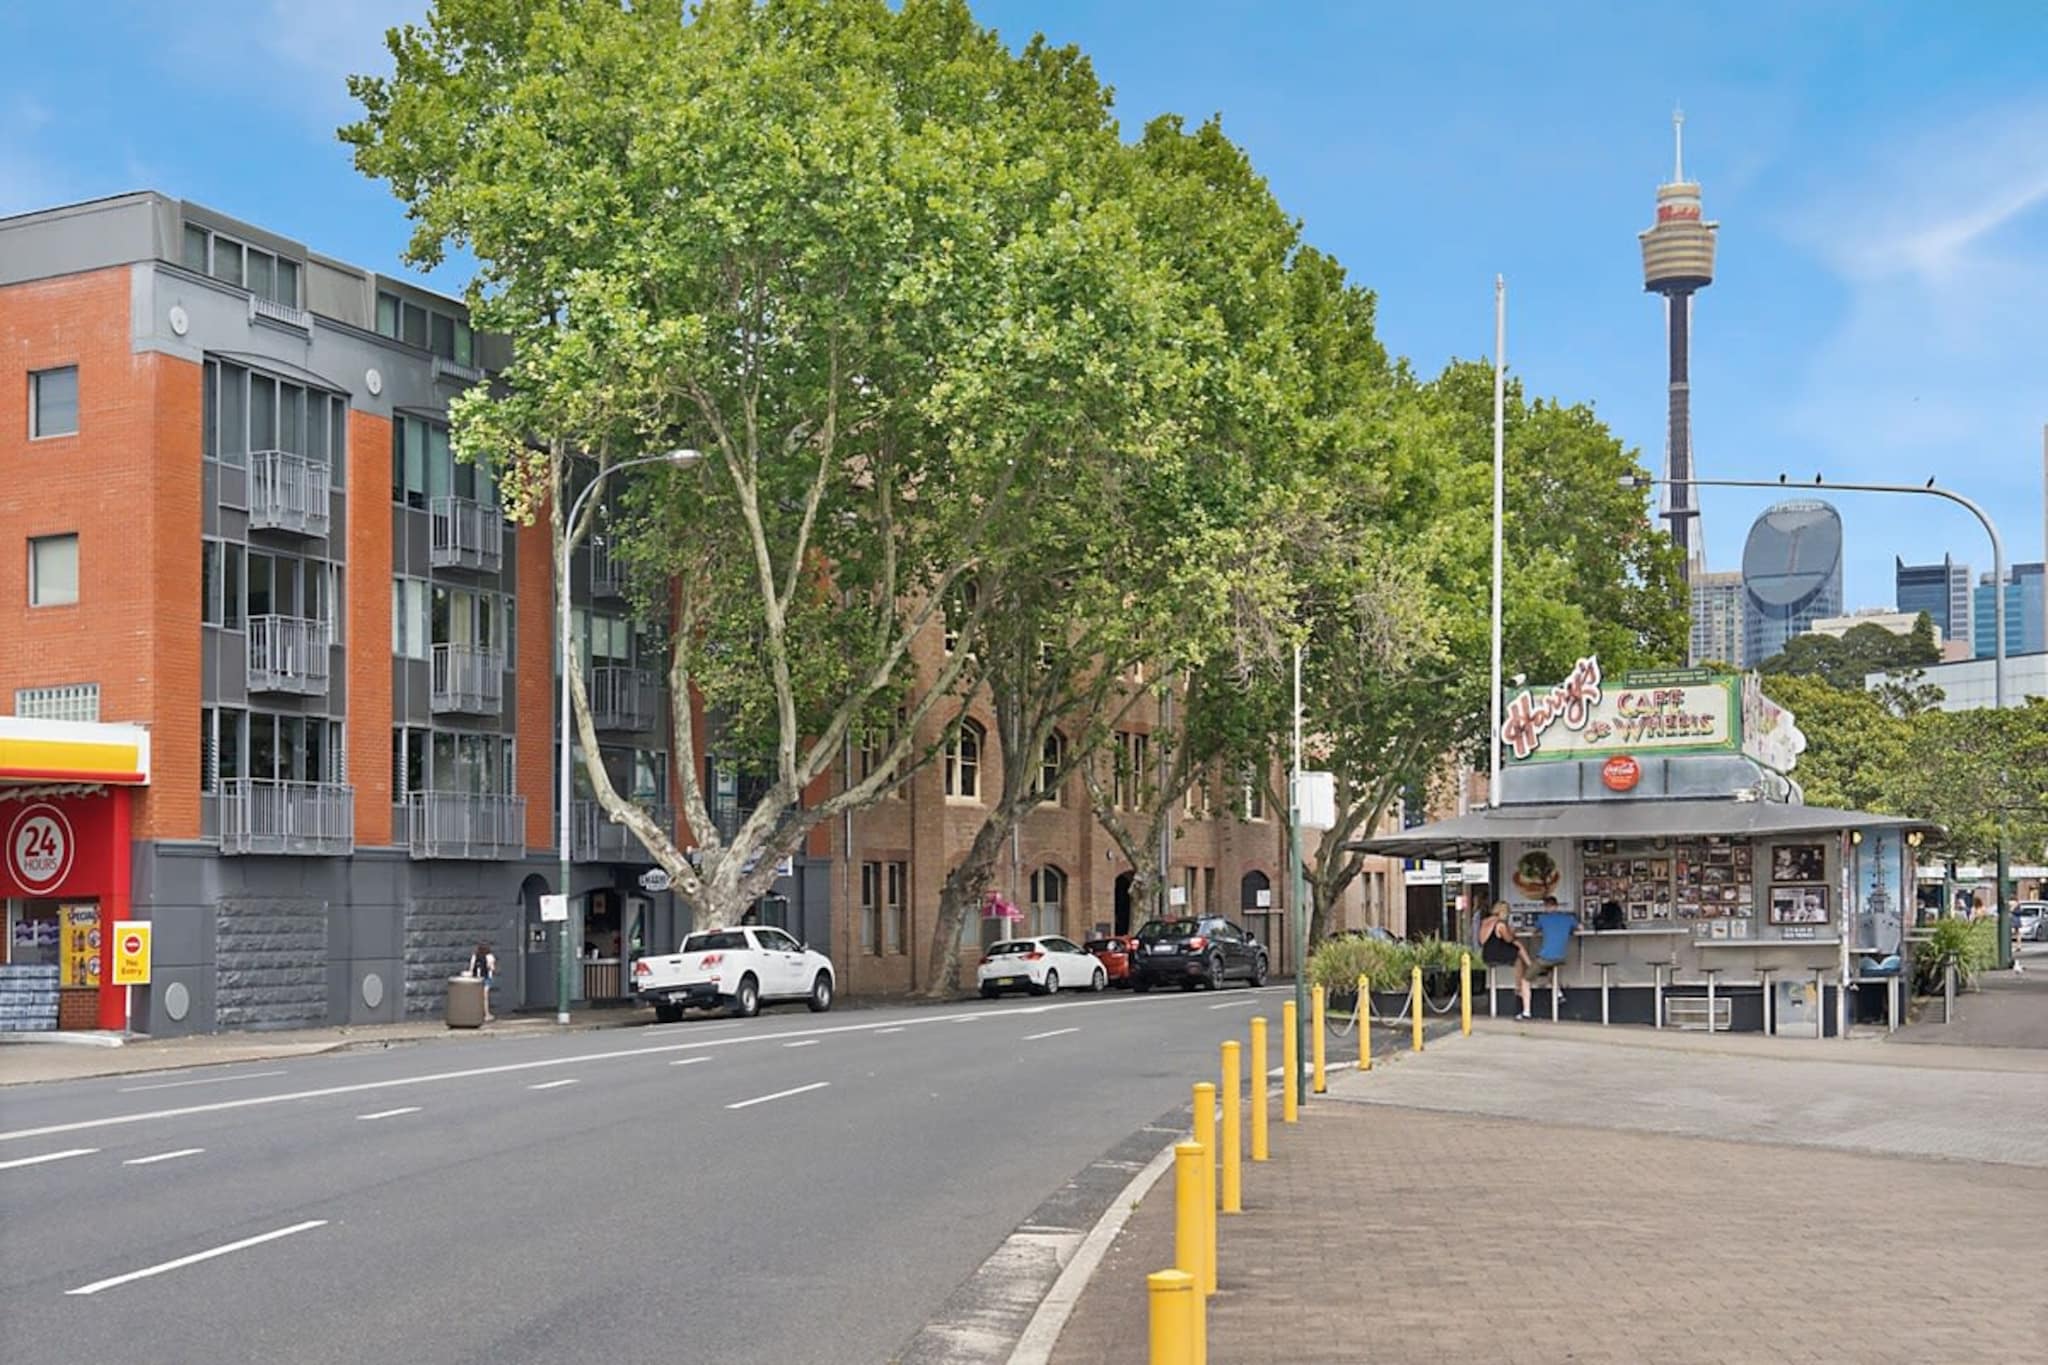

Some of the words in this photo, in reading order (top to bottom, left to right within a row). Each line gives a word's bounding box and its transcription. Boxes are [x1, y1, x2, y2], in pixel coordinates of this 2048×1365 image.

[1503, 657, 1599, 757] Harry's
[1617, 688, 1685, 718] CAFE
[1612, 713, 1715, 742] WHEELS
[25, 825, 57, 856] 24
[24, 858, 57, 871] HOURS
[121, 967, 142, 976] Entry
